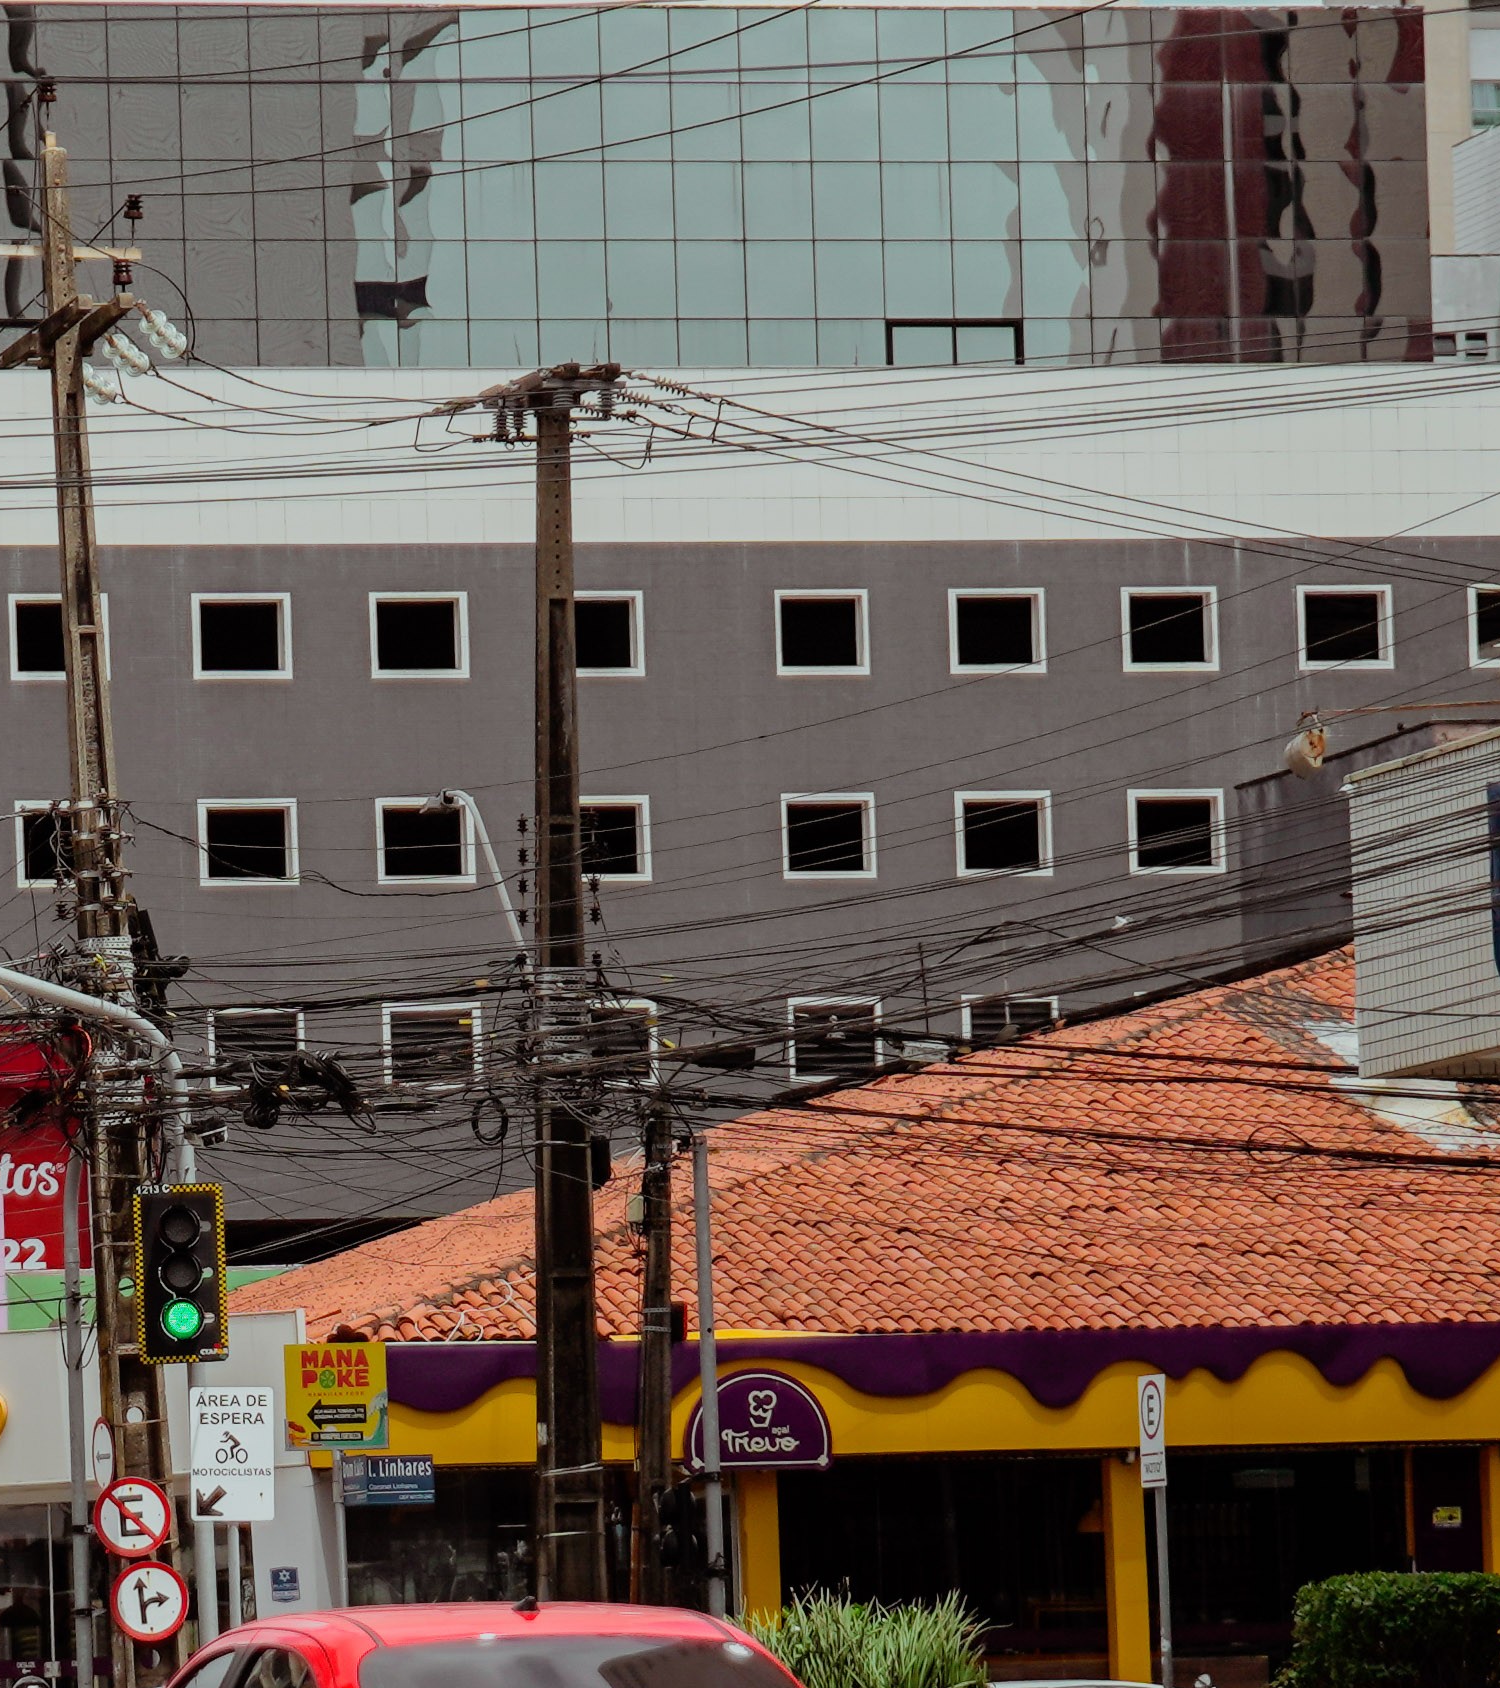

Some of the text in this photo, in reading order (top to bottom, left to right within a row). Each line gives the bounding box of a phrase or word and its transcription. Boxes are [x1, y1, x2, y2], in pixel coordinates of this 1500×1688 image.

[136, 1183, 170, 1195] 1213 C
[301, 1349, 369, 1368] MANA
[301, 1369, 370, 1389] POKE
[196, 1392, 267, 1407] ÁREA DE
[200, 1412, 265, 1425] ESPERA
[721, 1429, 800, 1453] Trevo
[192, 1468, 272, 1476] MOTOCICLISTAS
[380, 1459, 432, 1477] Linhares
[118, 1494, 145, 1537] E
